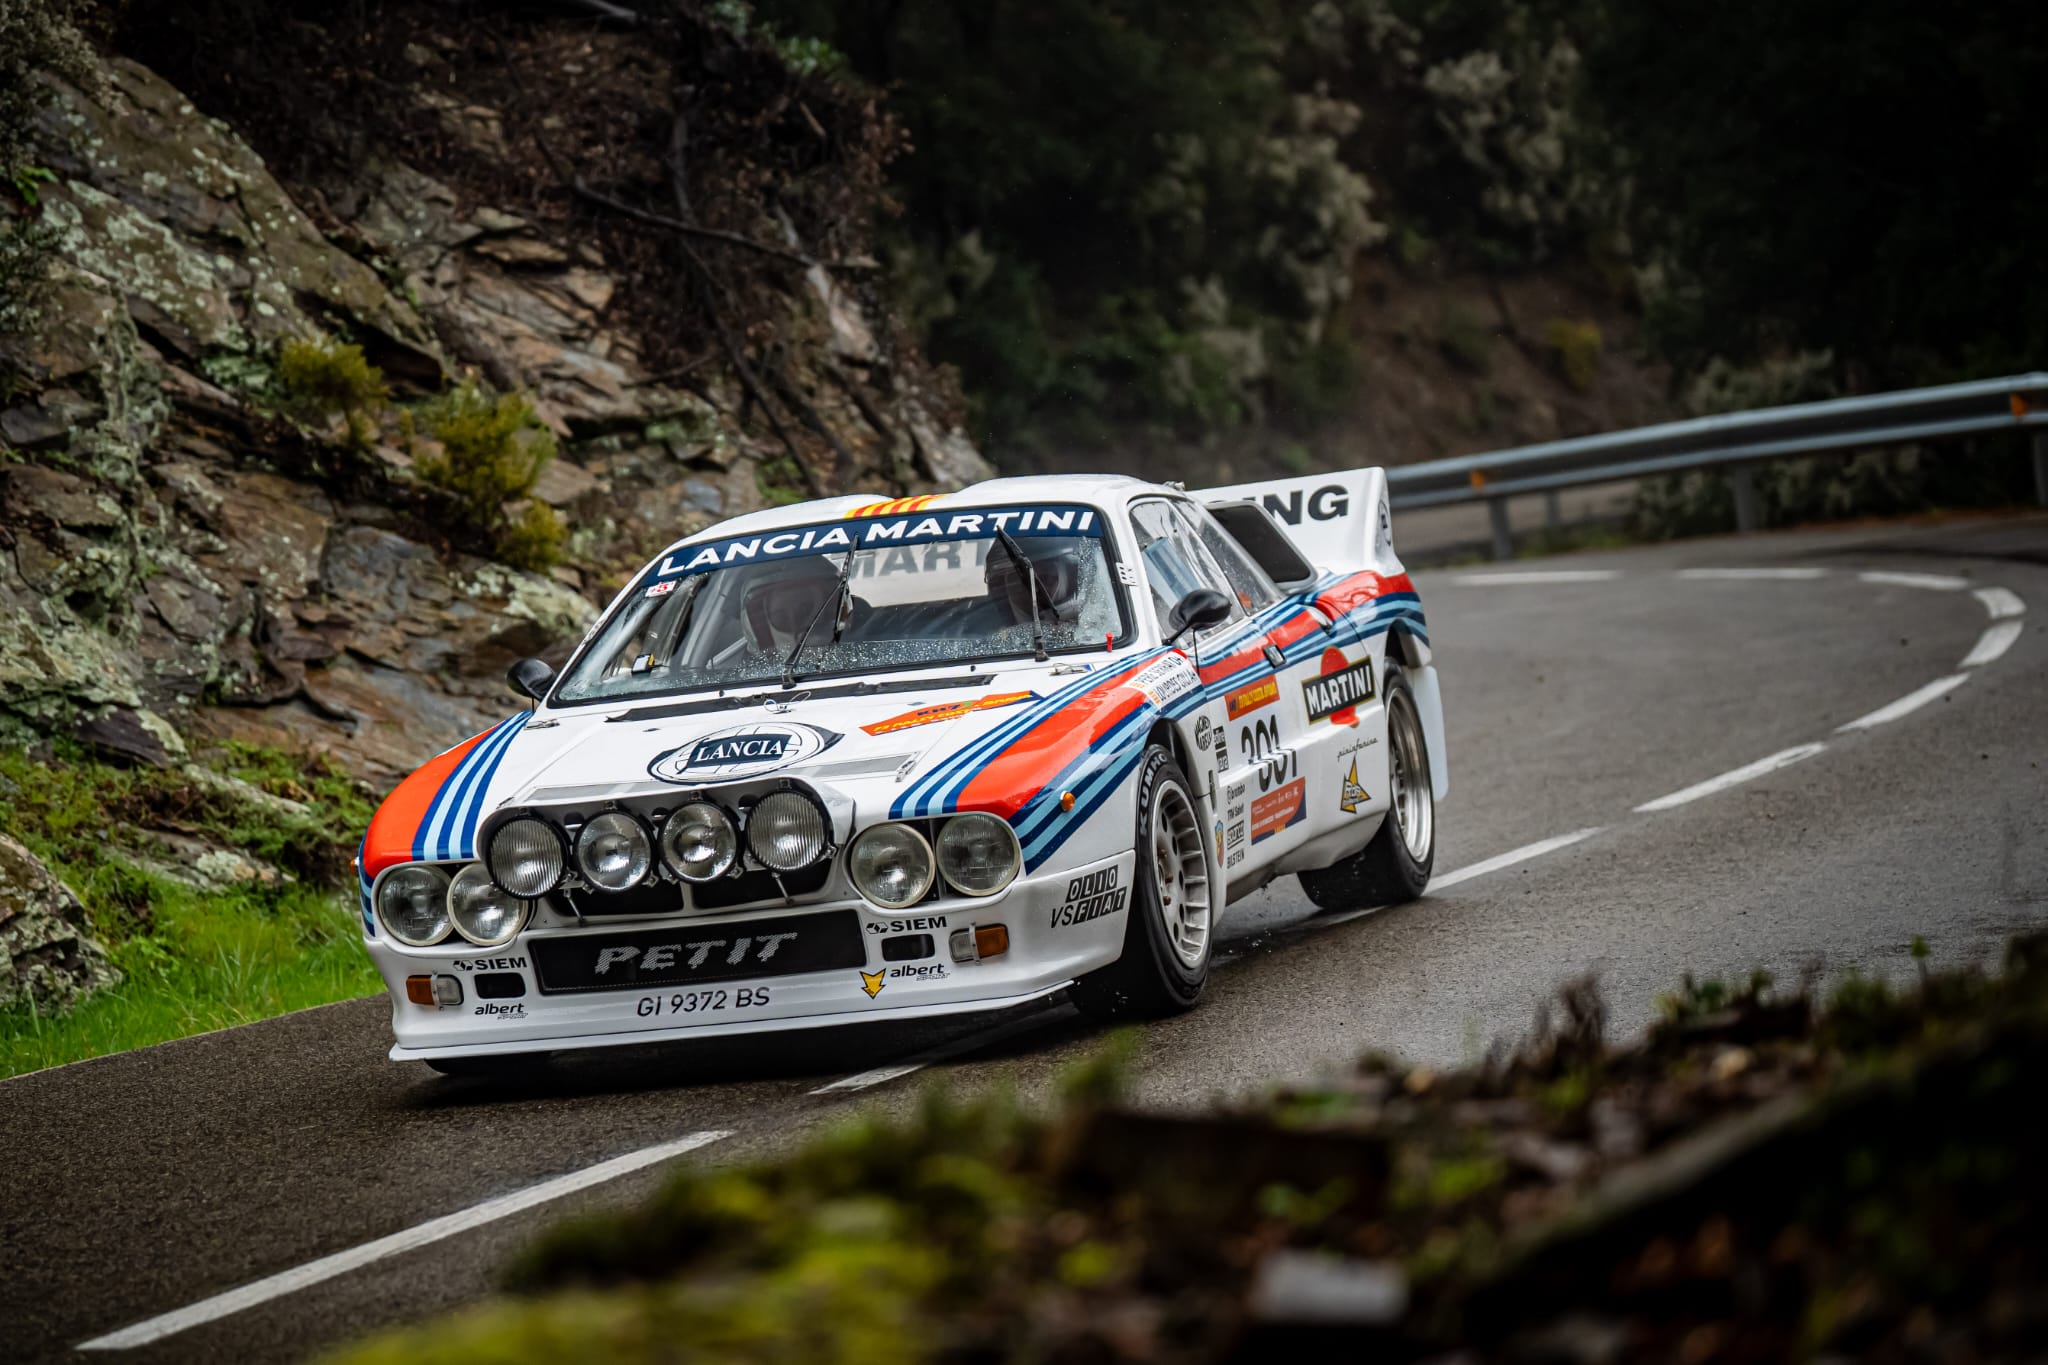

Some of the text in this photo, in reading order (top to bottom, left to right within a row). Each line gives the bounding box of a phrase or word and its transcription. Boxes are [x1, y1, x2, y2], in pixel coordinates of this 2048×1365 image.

[657, 511, 1094, 577] LANCIA MARTINI
[1305, 665, 1373, 716] MARTINI
[695, 739, 783, 763] LANCIA
[1241, 714, 1297, 792] 301
[1139, 752, 1169, 837] KUMHO
[1227, 848, 1245, 869] BILSTEIN
[1066, 865, 1118, 902] OLIO
[1072, 886, 1127, 925] FIAT
[891, 916, 947, 932] SIEM
[474, 957, 527, 970] SIEM
[595, 932, 798, 974] PETIT
[890, 963, 945, 978] albert
[474, 1003, 524, 1015] albert
[637, 987, 770, 1017] GI 9372 BS
